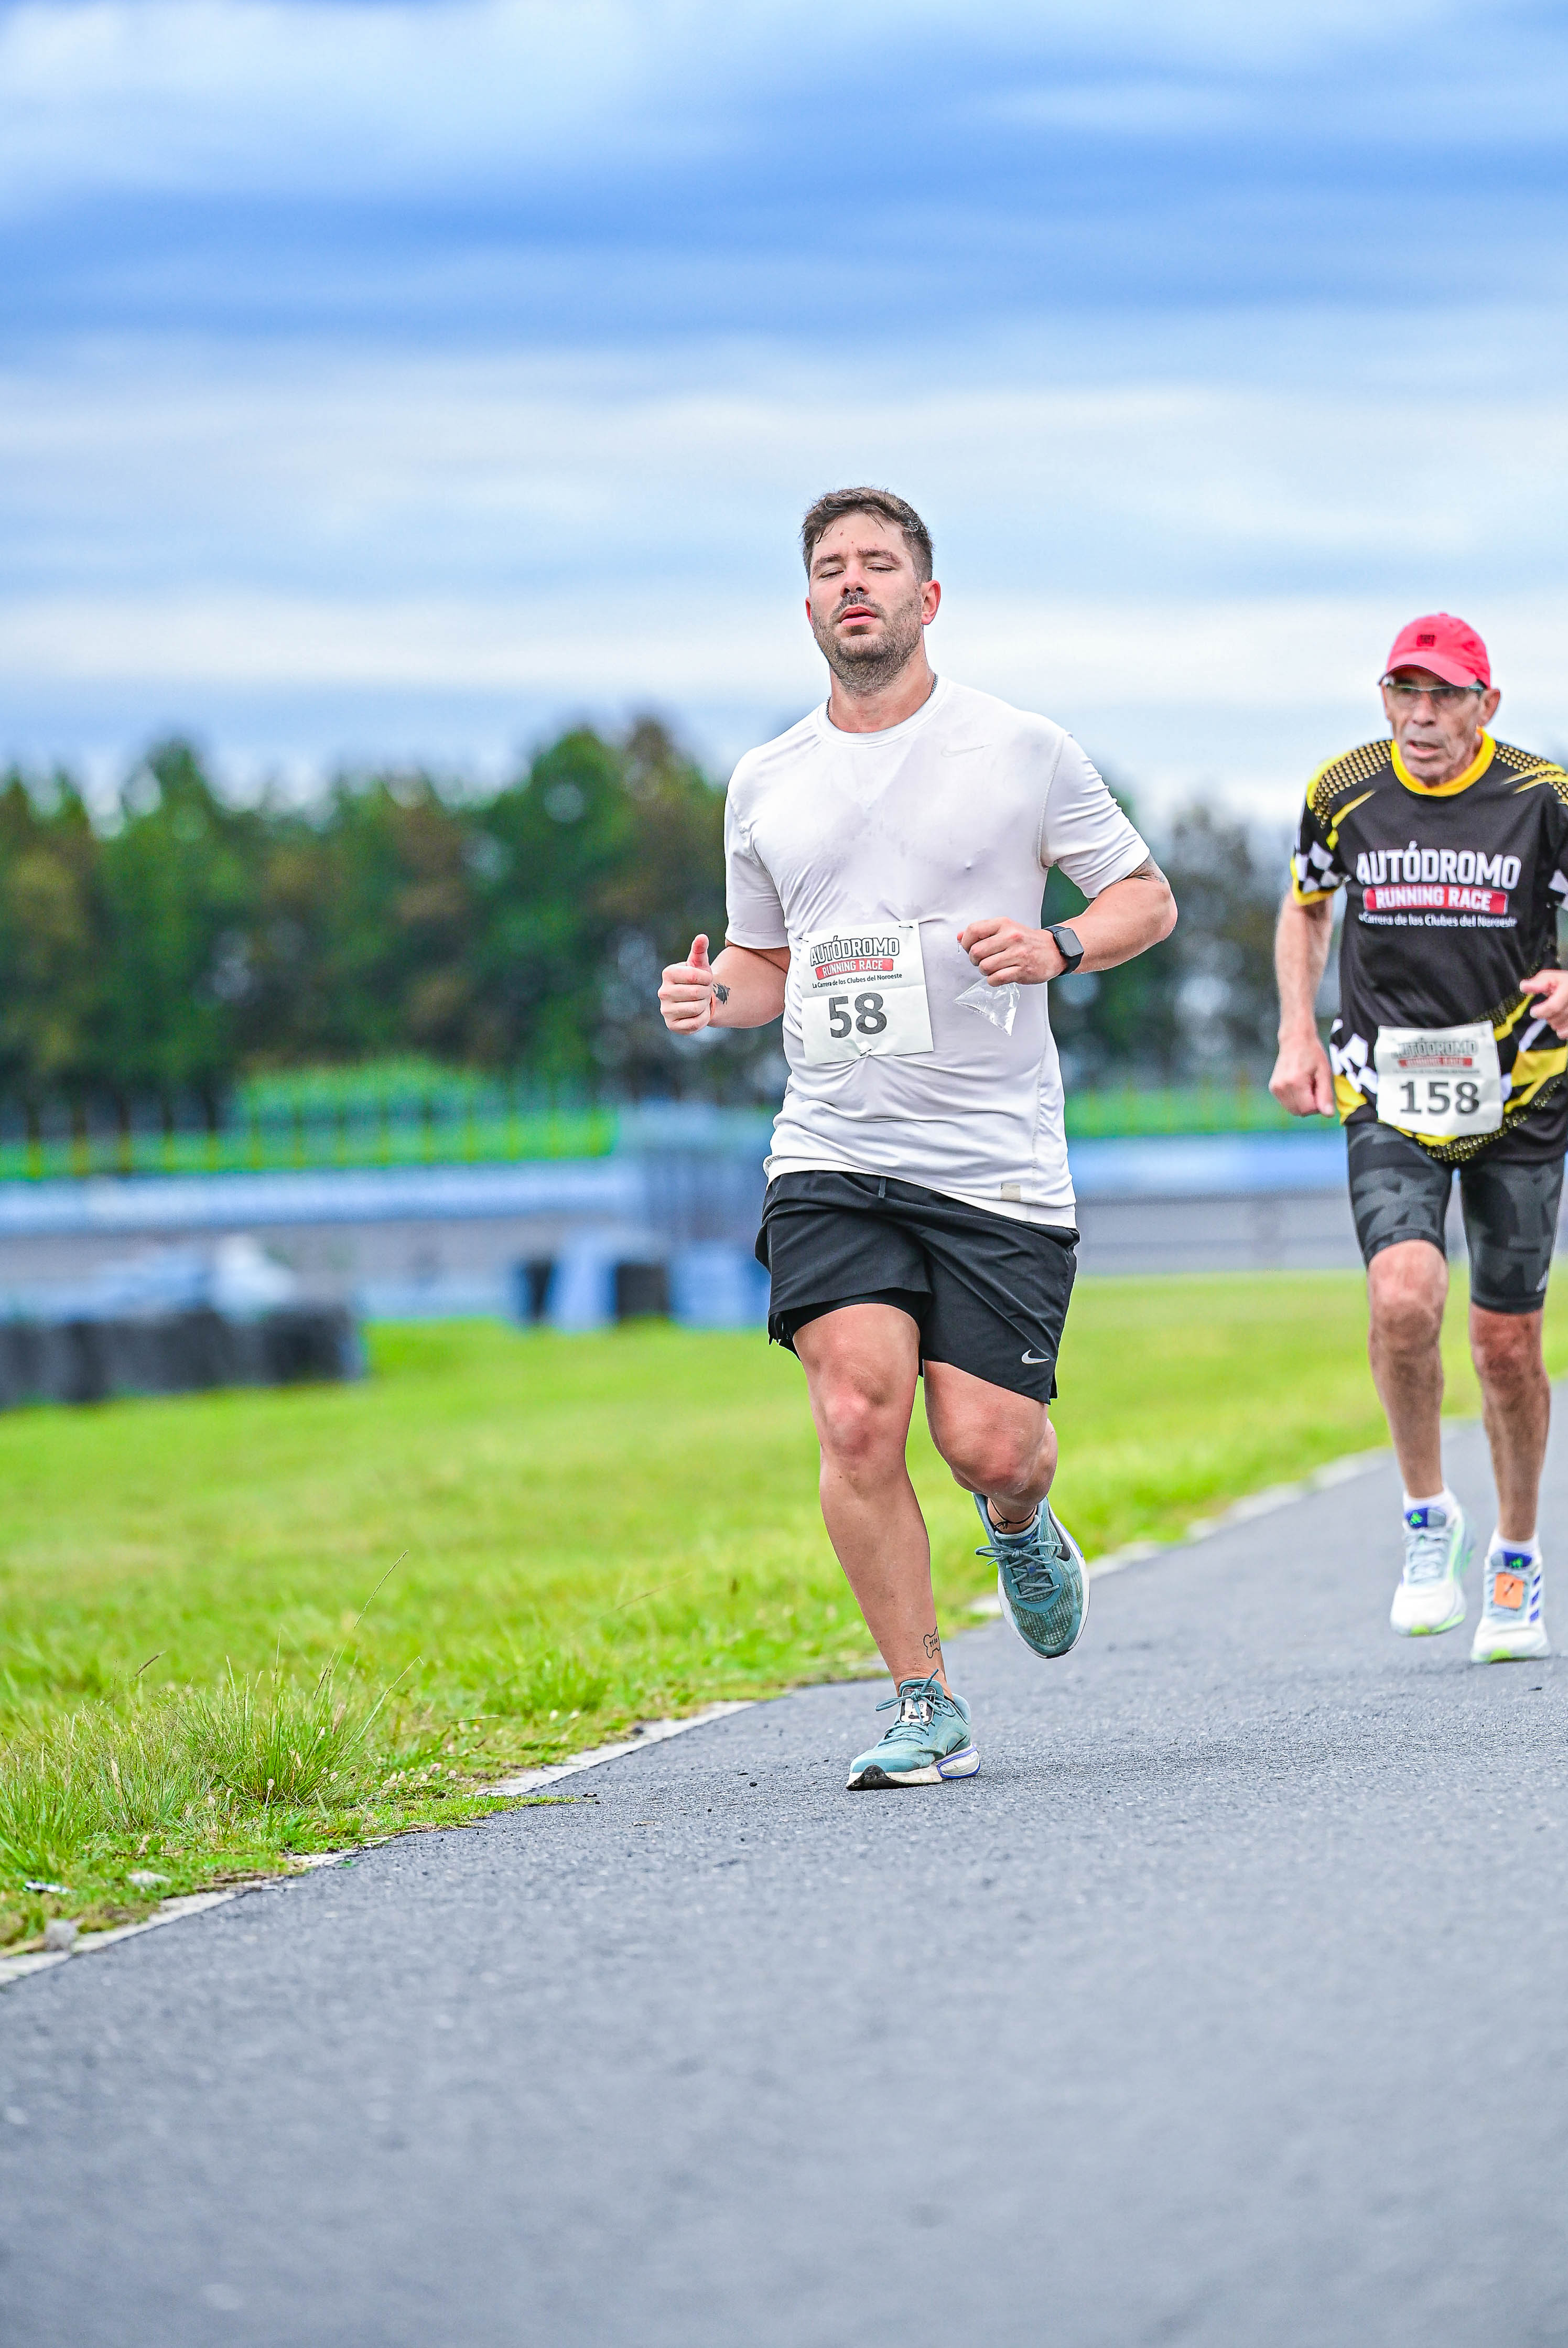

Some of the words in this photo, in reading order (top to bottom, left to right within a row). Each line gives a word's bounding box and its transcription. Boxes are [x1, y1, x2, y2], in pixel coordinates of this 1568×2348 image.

[1356, 840, 1521, 889] AUTÓDROMO
[1375, 886, 1444, 909] RUNNING
[1448, 887, 1492, 911] RACE
[1394, 912, 1408, 925] de
[1409, 912, 1424, 925] los
[1425, 913, 1458, 927] Clubes
[1459, 913, 1476, 927] del
[810, 935, 900, 966] AUTÓDROMO
[822, 960, 856, 977] RUNNING
[859, 960, 883, 971] RACE
[829, 993, 887, 1038] 58
[1400, 1081, 1480, 1116] 158
